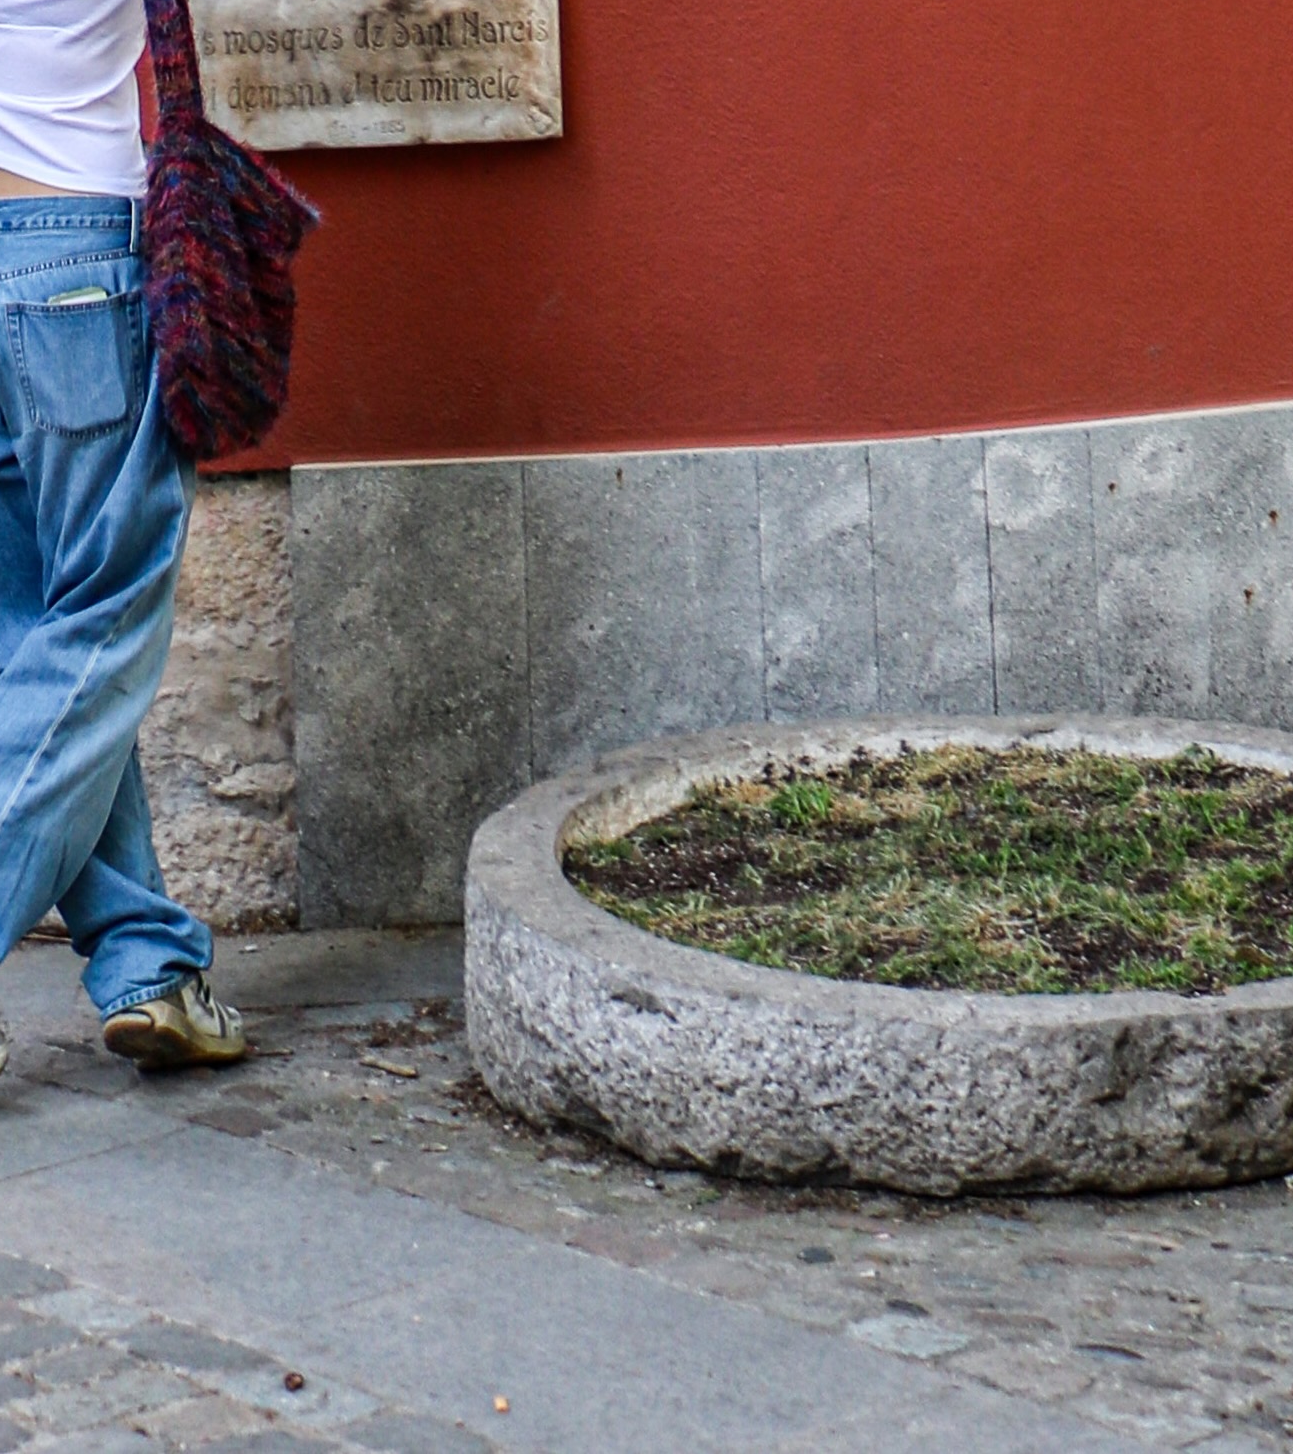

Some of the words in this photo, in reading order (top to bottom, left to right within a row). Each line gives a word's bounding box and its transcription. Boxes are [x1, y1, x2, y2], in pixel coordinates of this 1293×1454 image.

[223, 25, 344, 63] mosques
[354, 12, 385, 50] de
[392, 11, 453, 47] Sant
[227, 76, 331, 113] demana
[342, 71, 361, 109] el
[370, 73, 413, 106] teu
[420, 66, 521, 102] miracle
